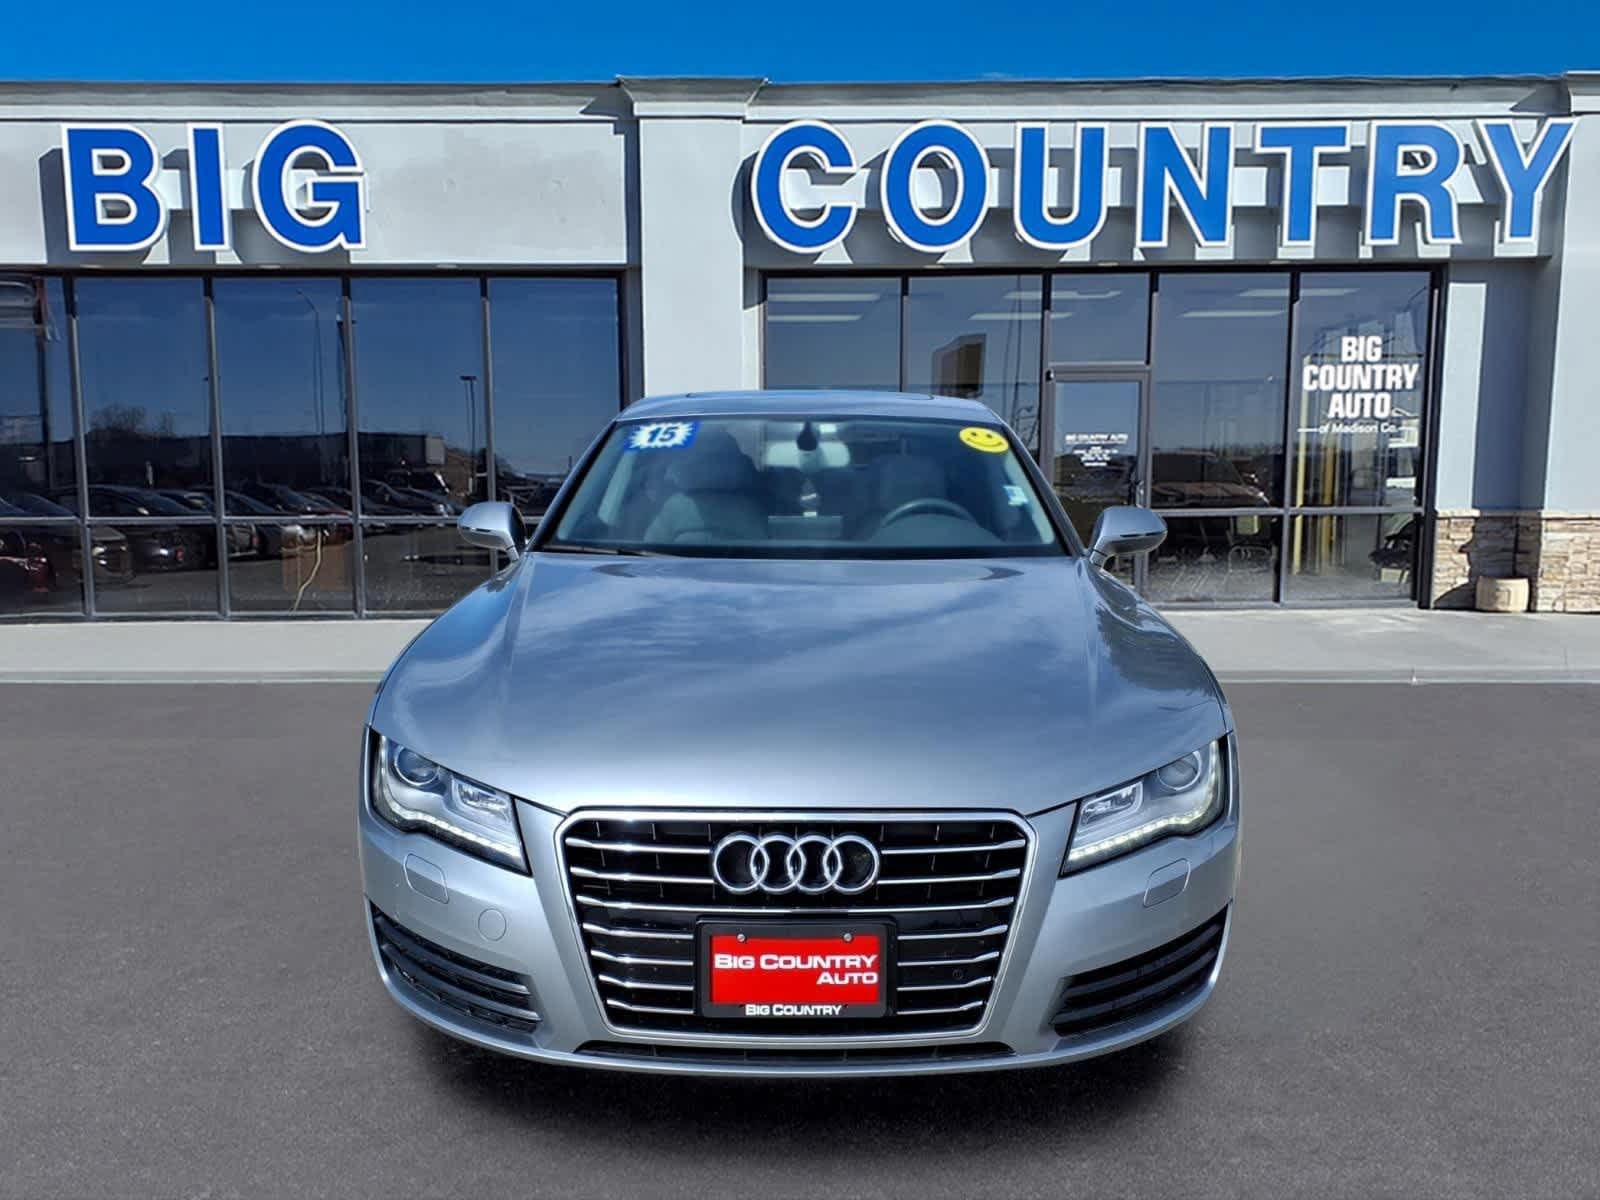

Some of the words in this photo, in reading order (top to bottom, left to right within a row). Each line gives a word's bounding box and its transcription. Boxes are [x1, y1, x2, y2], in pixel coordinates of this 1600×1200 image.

[61, 119, 366, 252] BIG
[750, 119, 1574, 254] COUNTRY
[1341, 335, 1383, 362] BIG
[1303, 363, 1419, 391] COUNTRY
[1328, 392, 1391, 419] AUTO
[647, 426, 679, 443] 15
[1331, 421, 1378, 433] Madison
[714, 953, 756, 970] BIG
[760, 953, 878, 970] COUNTRY
[816, 971, 879, 986] AUTO
[772, 1003, 842, 1016] COUNTRY
